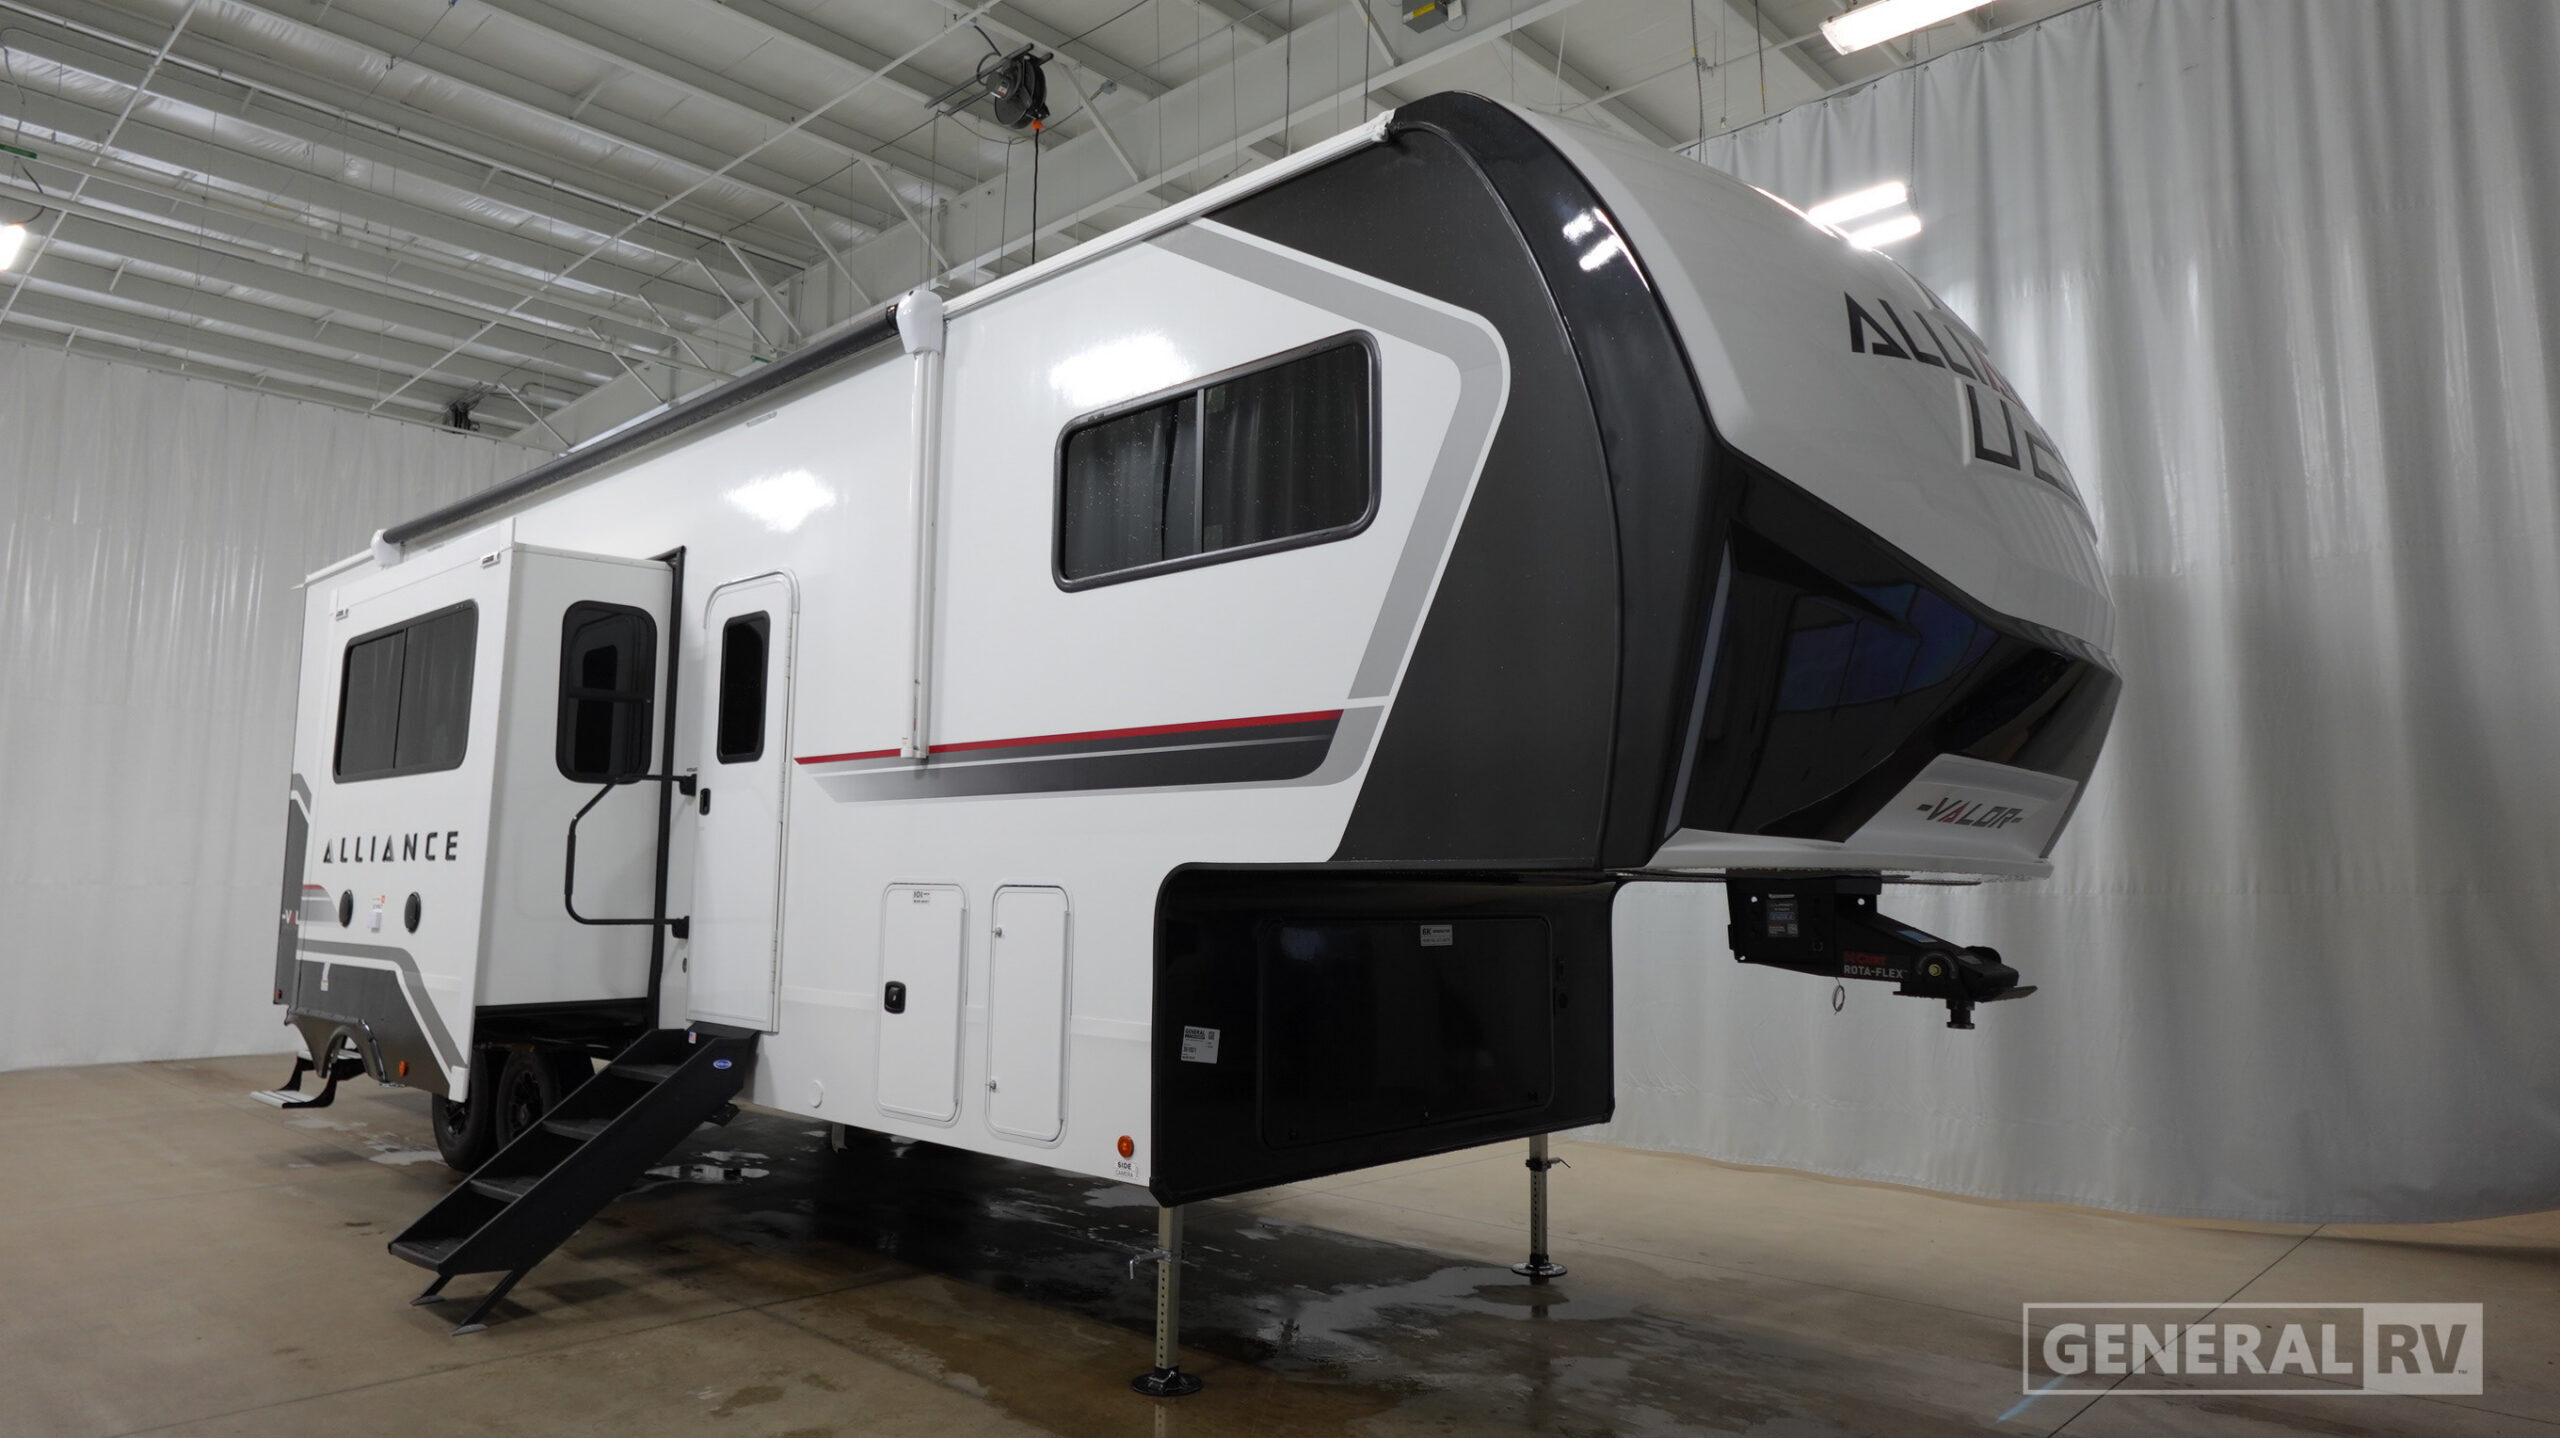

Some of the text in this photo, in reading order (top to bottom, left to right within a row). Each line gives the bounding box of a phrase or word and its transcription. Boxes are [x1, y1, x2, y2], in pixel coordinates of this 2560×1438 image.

[323, 831, 459, 863] ALLIANCE
[1843, 964, 1904, 979] ROTA-FLEX
[1117, 1161, 1132, 1170] SIDE
